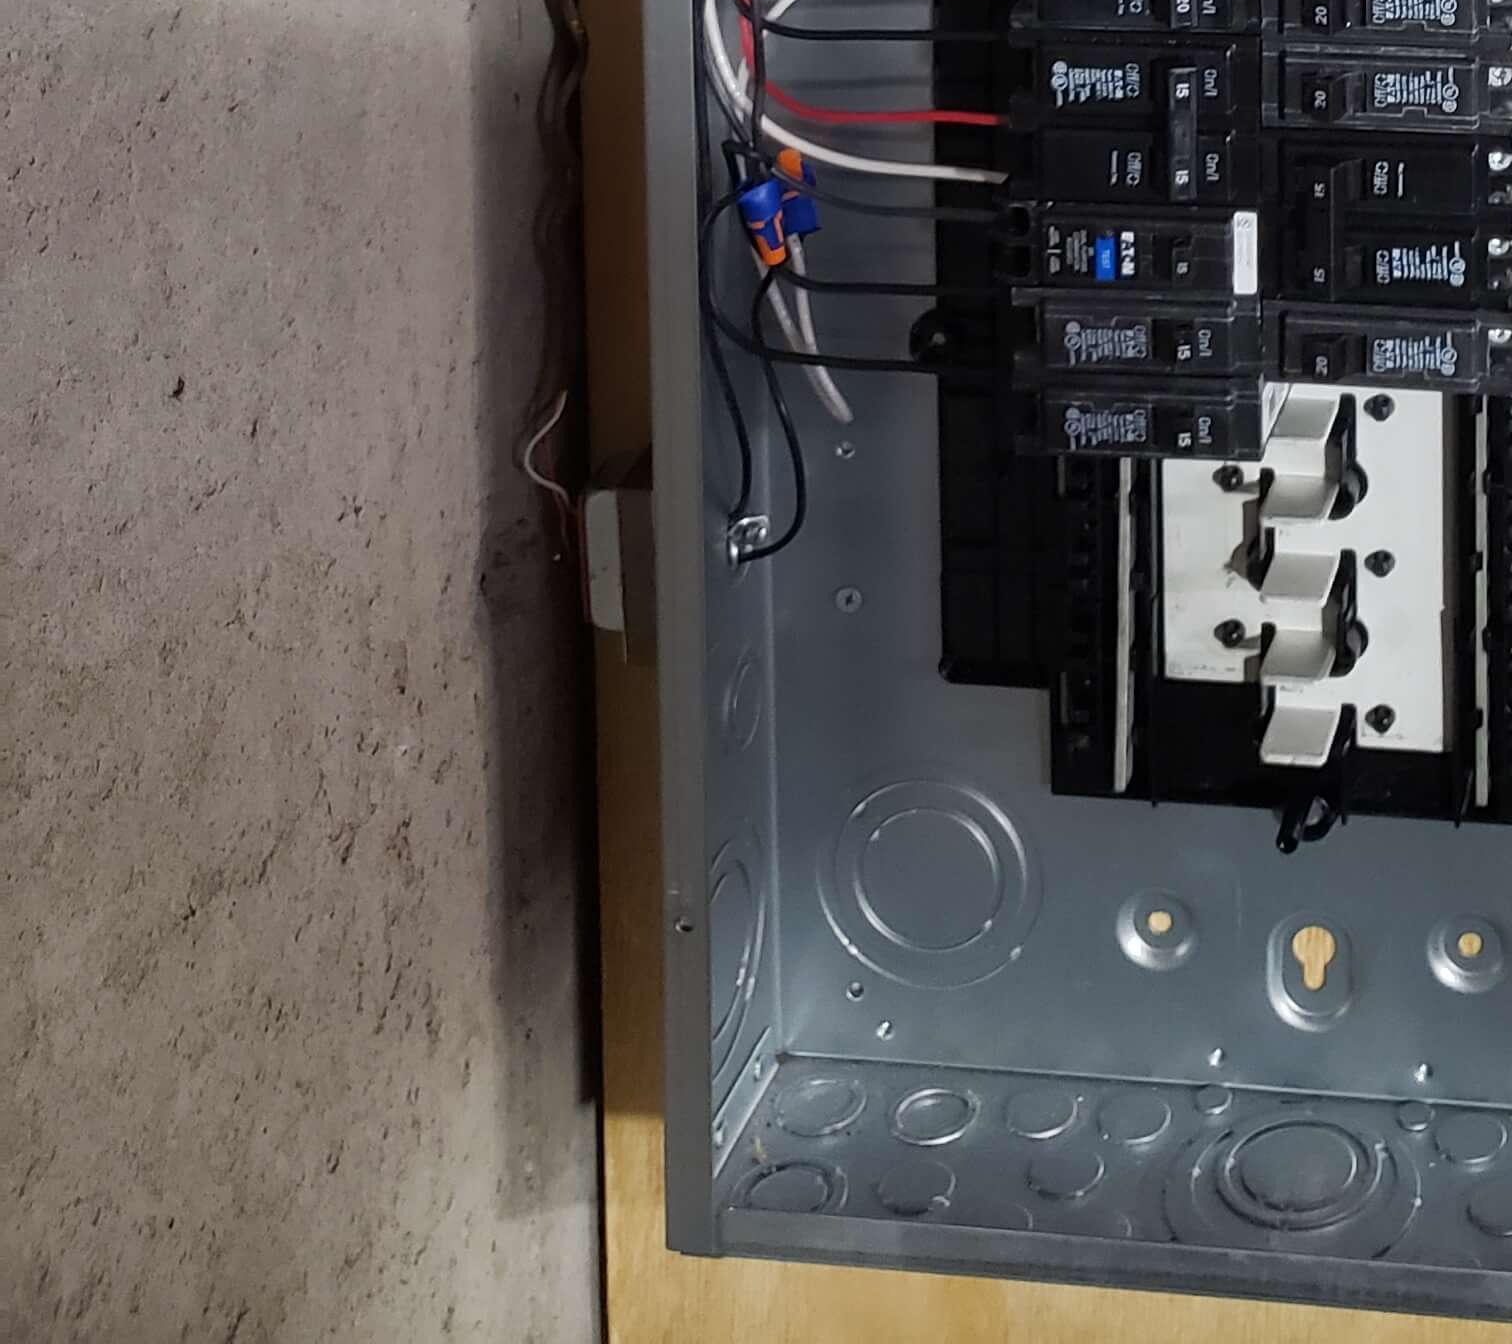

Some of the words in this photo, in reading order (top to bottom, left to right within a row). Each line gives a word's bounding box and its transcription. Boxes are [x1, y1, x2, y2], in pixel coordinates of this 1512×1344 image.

[1314, 6, 1328, 25] 20
[1176, 83, 1188, 98] 15
[1315, 90, 1327, 109] 20
[1176, 169, 1188, 184] 15
[1176, 262, 1188, 274] 15
[1314, 268, 1325, 283] 15
[1177, 345, 1192, 360] 15
[1316, 356, 1327, 376] 20
[1178, 432, 1192, 448] 15
